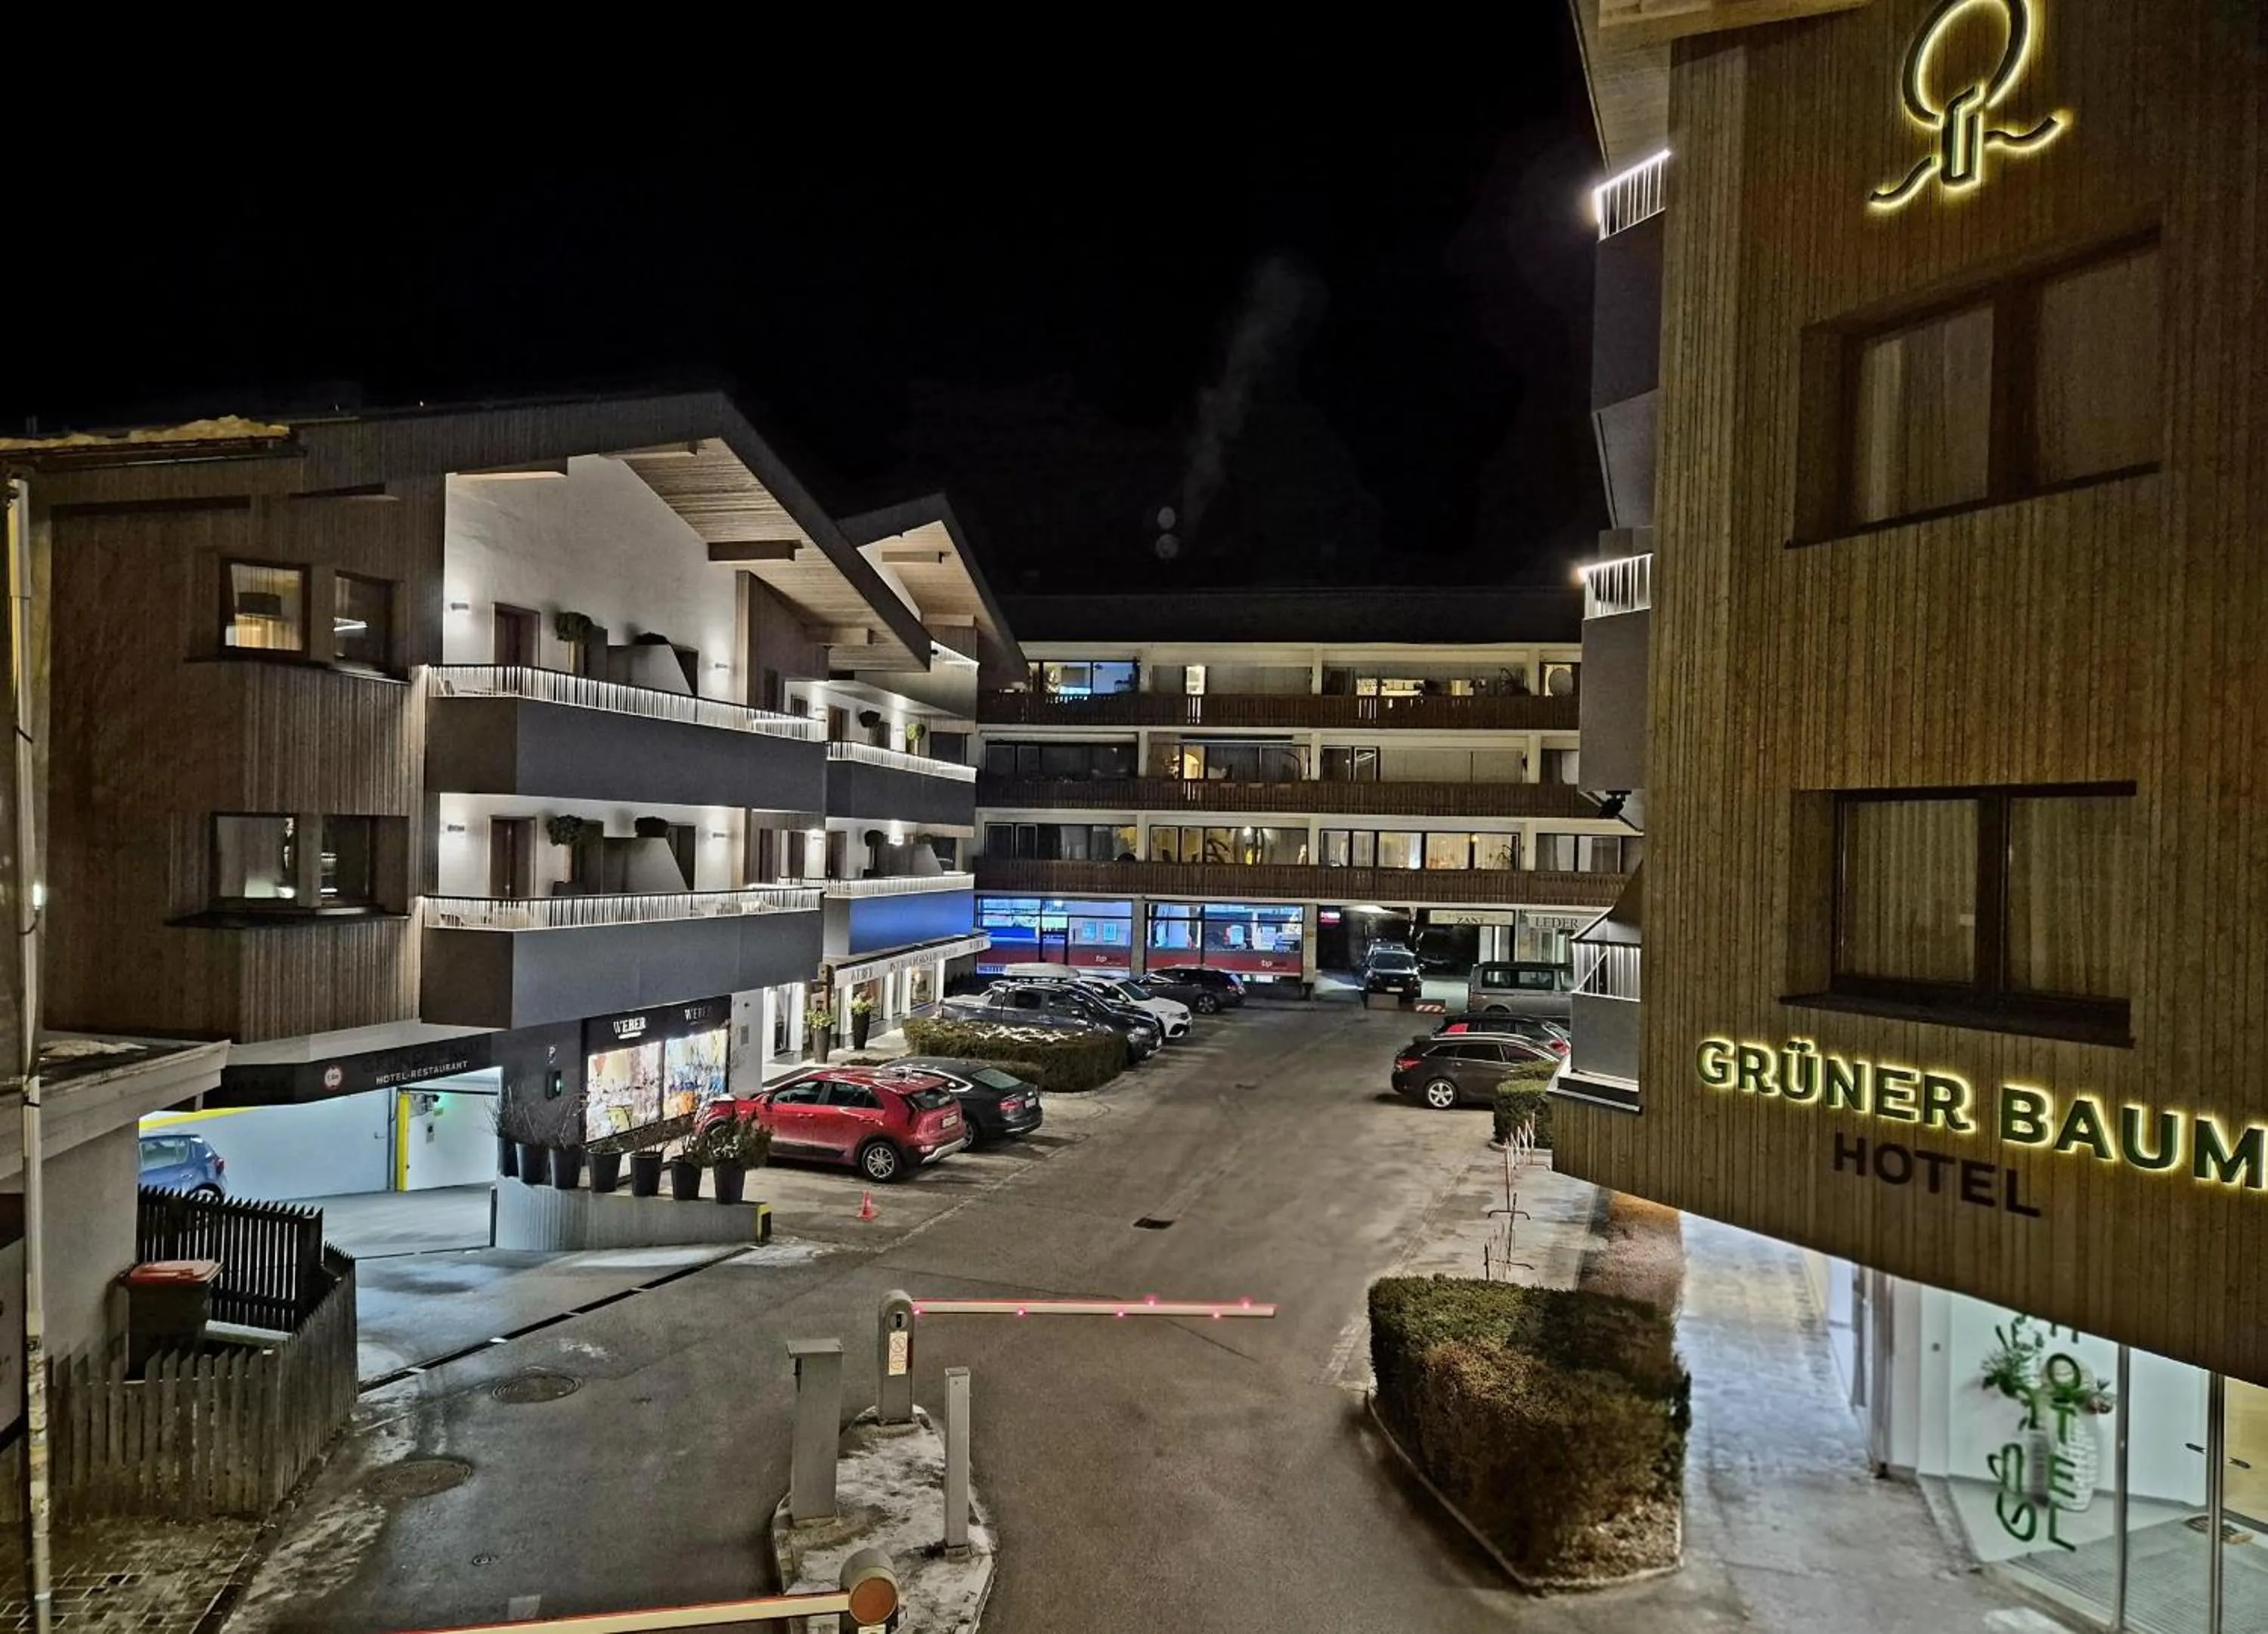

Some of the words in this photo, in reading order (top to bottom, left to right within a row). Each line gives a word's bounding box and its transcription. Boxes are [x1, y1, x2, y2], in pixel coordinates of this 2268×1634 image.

[1535, 916, 1578, 929] LEDER
[613, 1017, 646, 1035] WEBER
[376, 1060, 469, 1085] HOTEL-RESTAURANT
[1696, 1038, 1975, 1133] GRÜNER
[2000, 1085, 2266, 1189] BAUM
[1833, 1132, 2041, 1218] HOTEL
